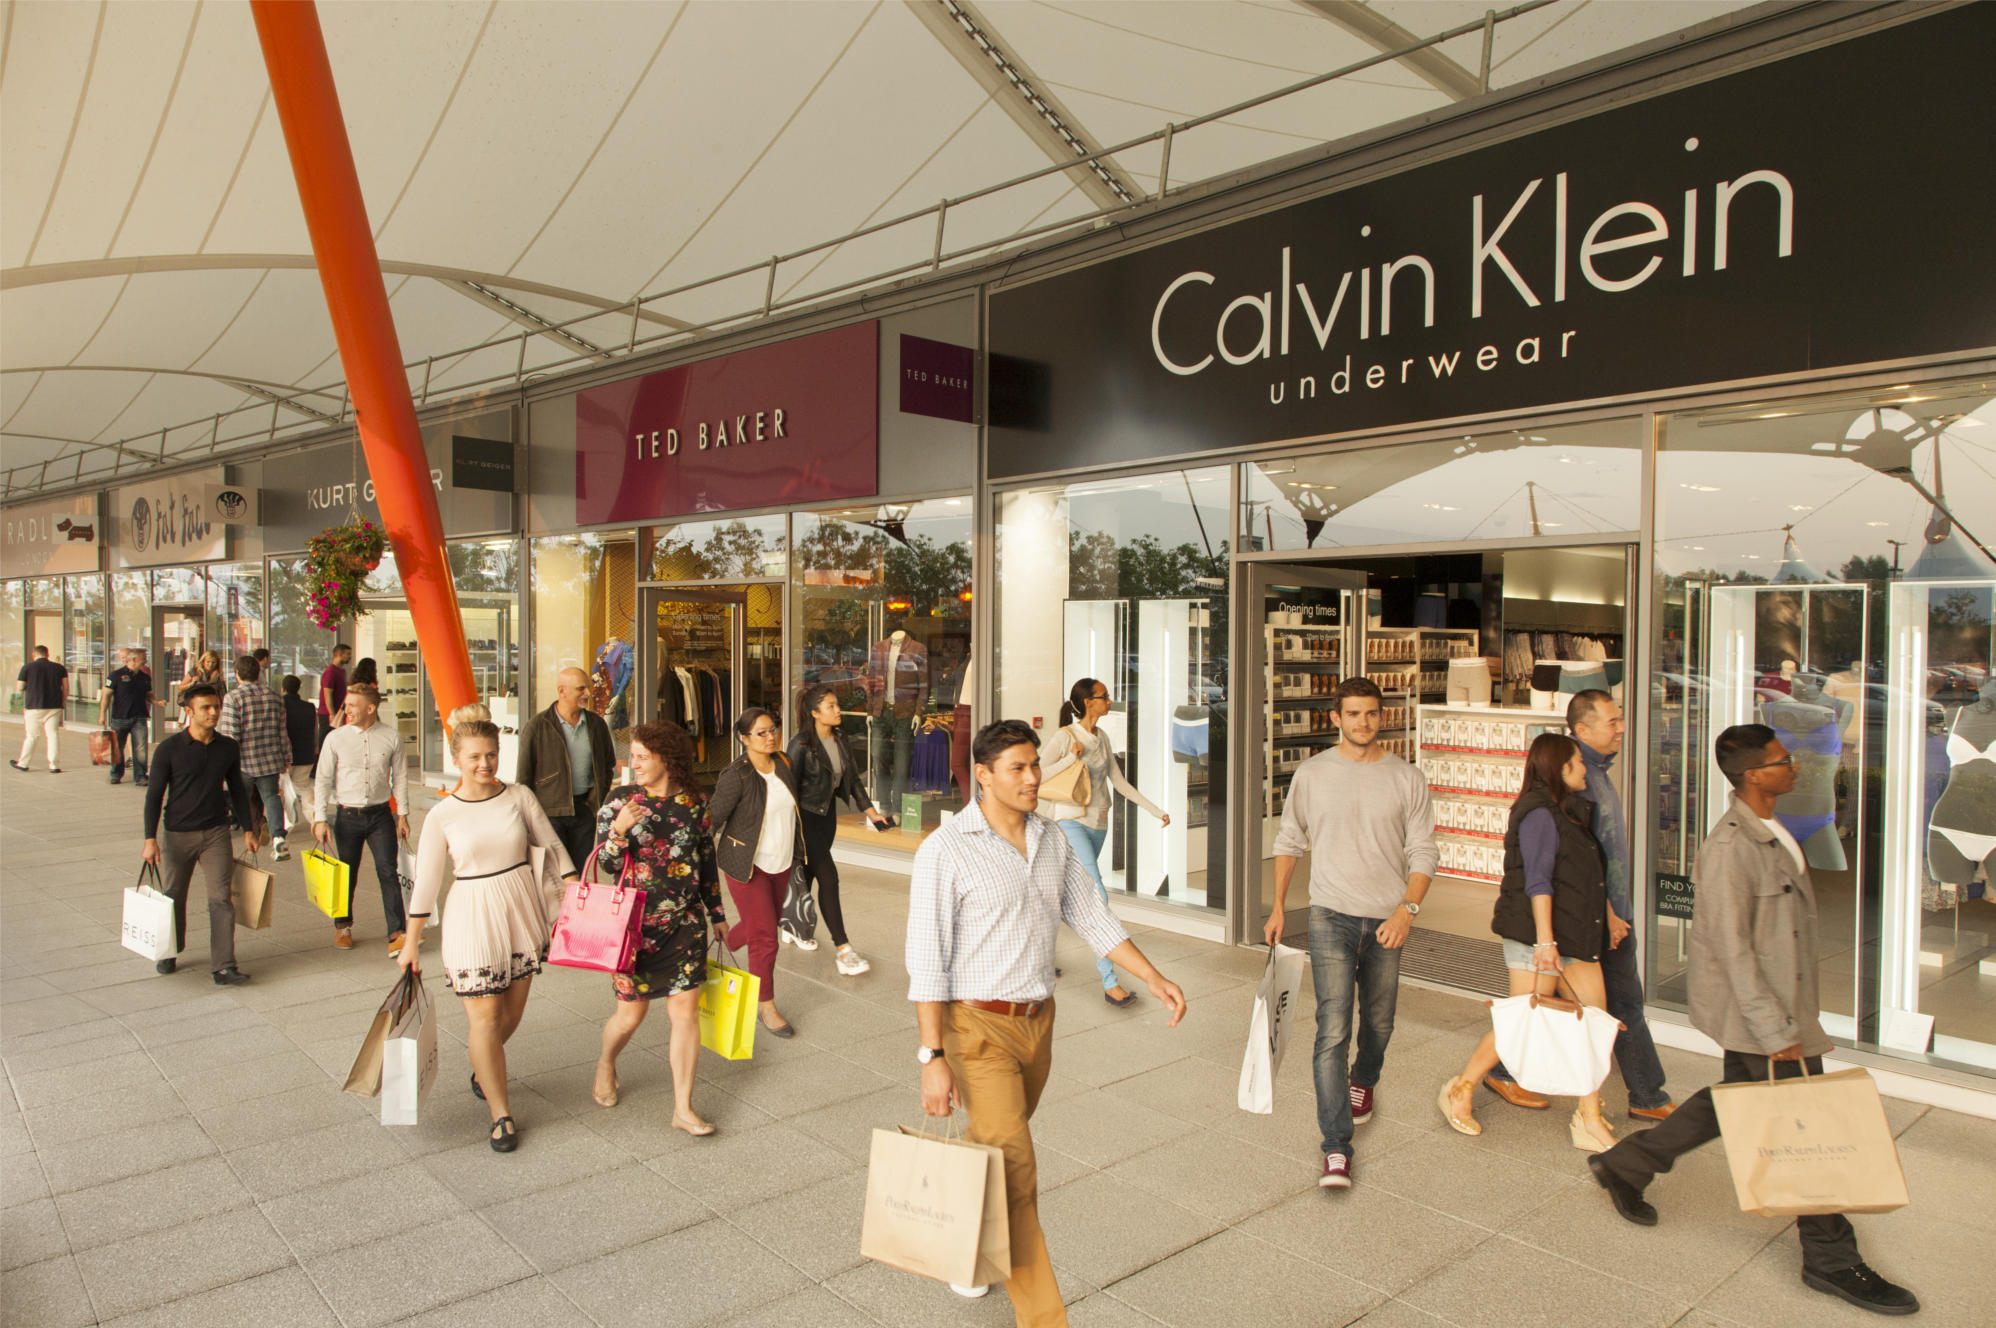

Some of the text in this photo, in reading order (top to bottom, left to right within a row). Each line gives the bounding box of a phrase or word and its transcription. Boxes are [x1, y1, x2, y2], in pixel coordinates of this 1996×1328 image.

[1151, 137, 1793, 376] Calvin Klein
[907, 369, 968, 389] TED BAKER
[1270, 329, 1577, 405] underwear
[635, 408, 784, 460] TED BAKER
[307, 483, 356, 510] KURT
[7, 517, 48, 545] RADL
[1279, 602, 1336, 618] Opening times
[1660, 880, 1683, 892] FIND
[1674, 904, 1695, 914] FITTIN
[124, 922, 156, 947] REISS
